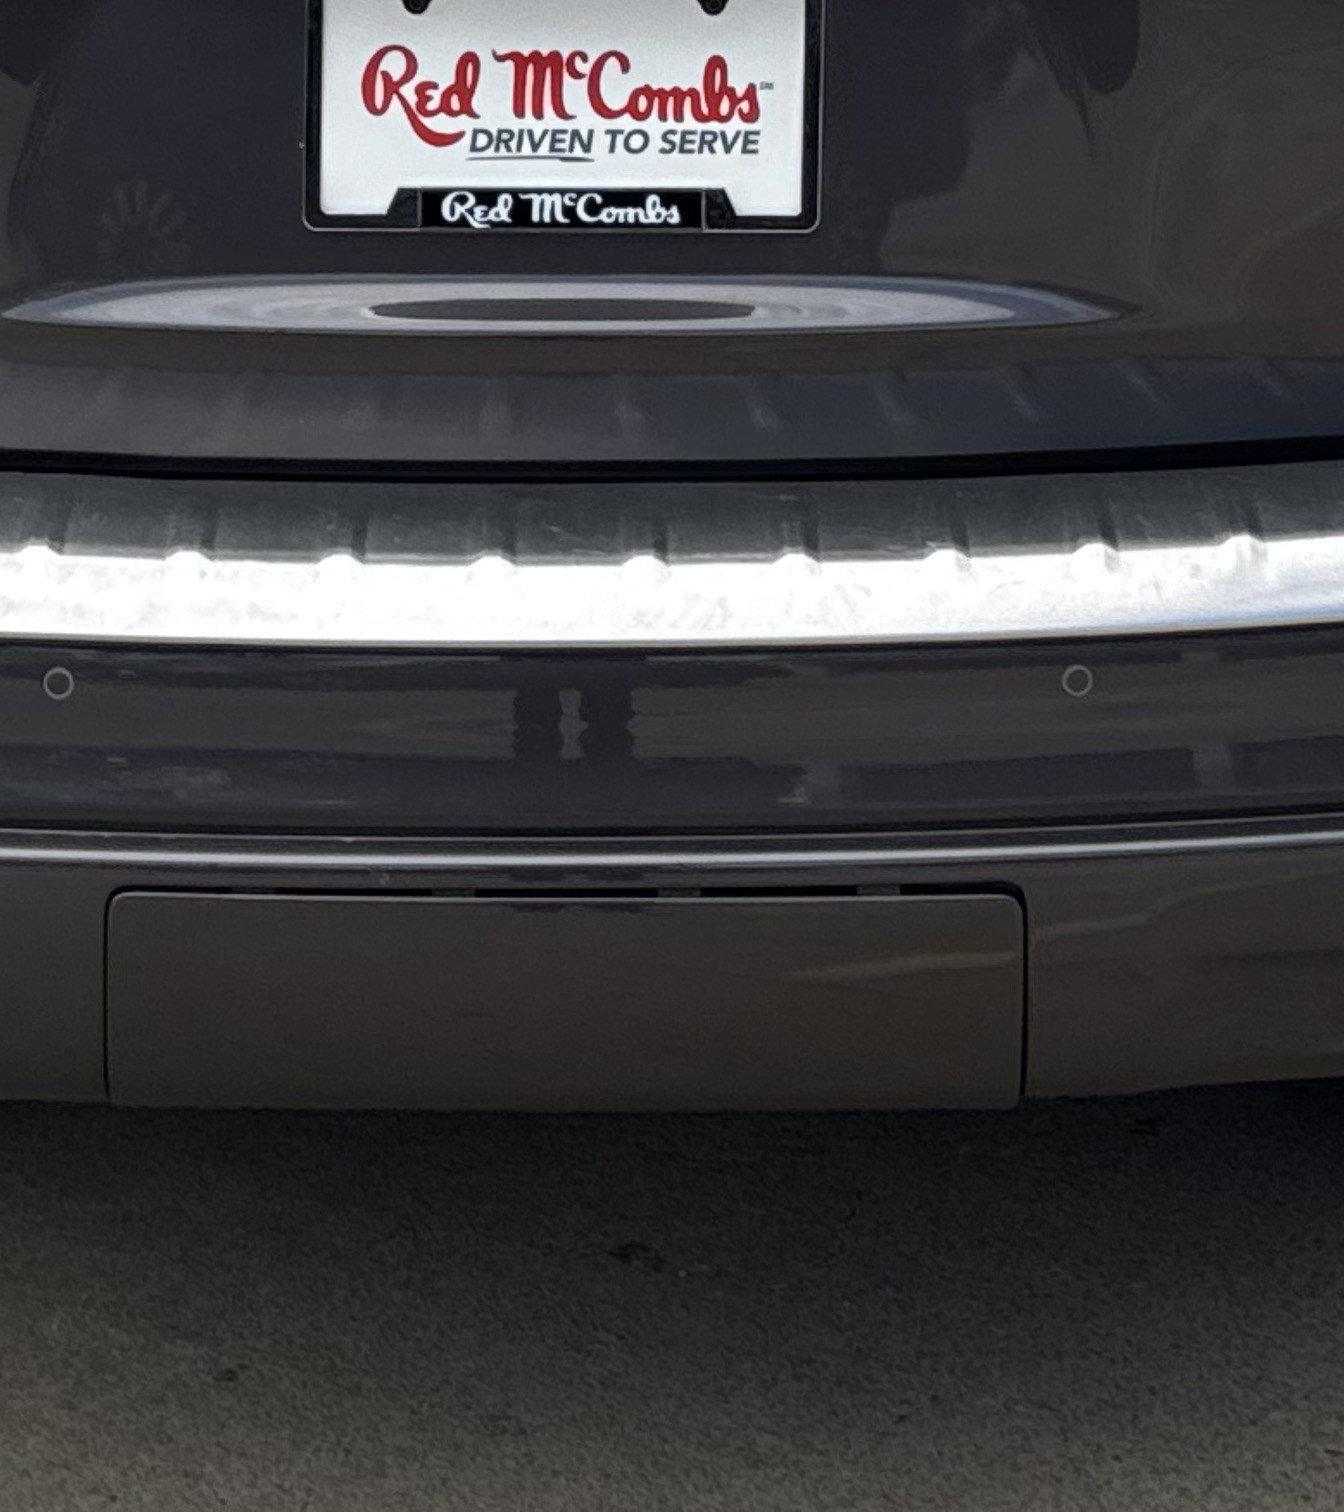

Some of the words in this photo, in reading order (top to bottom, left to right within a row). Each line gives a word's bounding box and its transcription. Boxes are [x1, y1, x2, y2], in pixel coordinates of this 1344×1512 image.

[361, 43, 482, 147] Red
[491, 49, 761, 124] McCombs
[469, 128, 594, 154] DRIVEN
[606, 128, 650, 155] TO
[659, 129, 761, 155] SERVE
[441, 190, 513, 230] Red
[520, 191, 682, 226] McCombs
